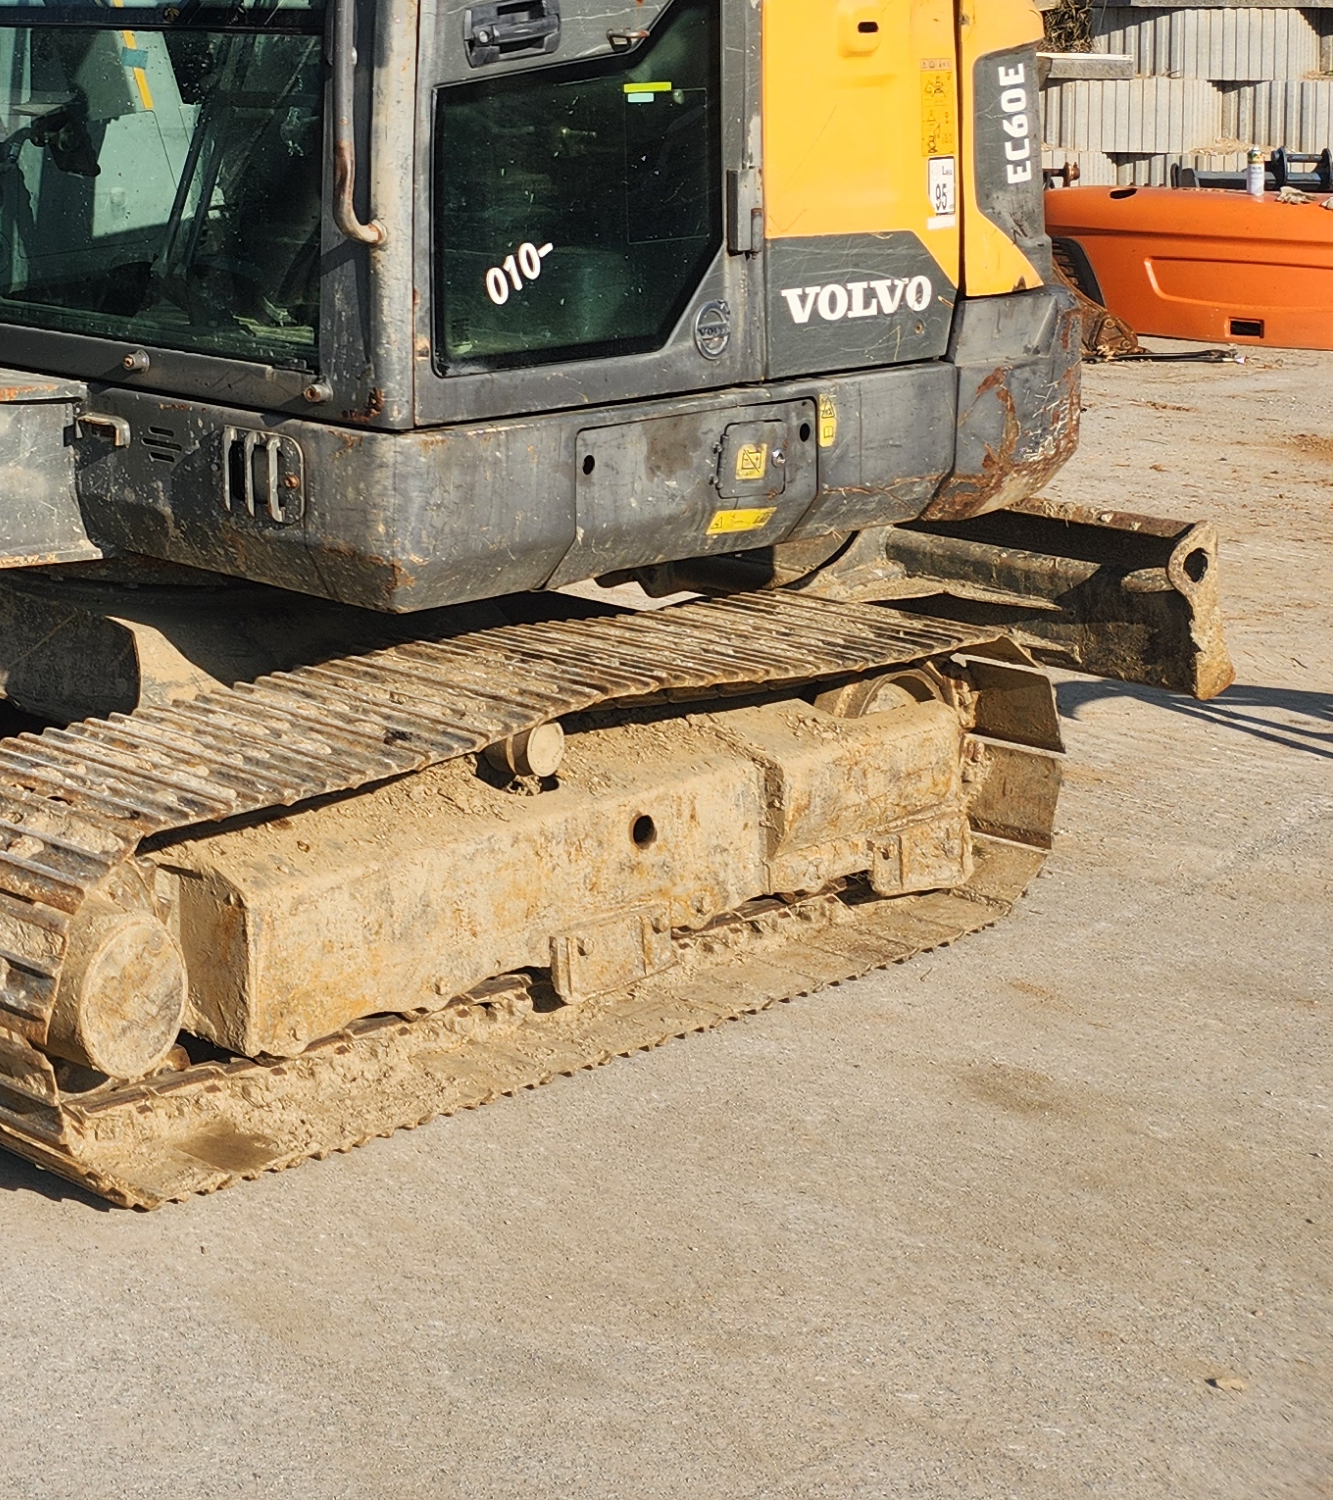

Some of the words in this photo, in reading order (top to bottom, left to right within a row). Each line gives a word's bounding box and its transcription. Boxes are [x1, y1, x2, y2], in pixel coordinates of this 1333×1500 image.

[997, 62, 1033, 184] EC60E
[935, 182, 948, 211] 95
[780, 274, 933, 325] VOLVO
